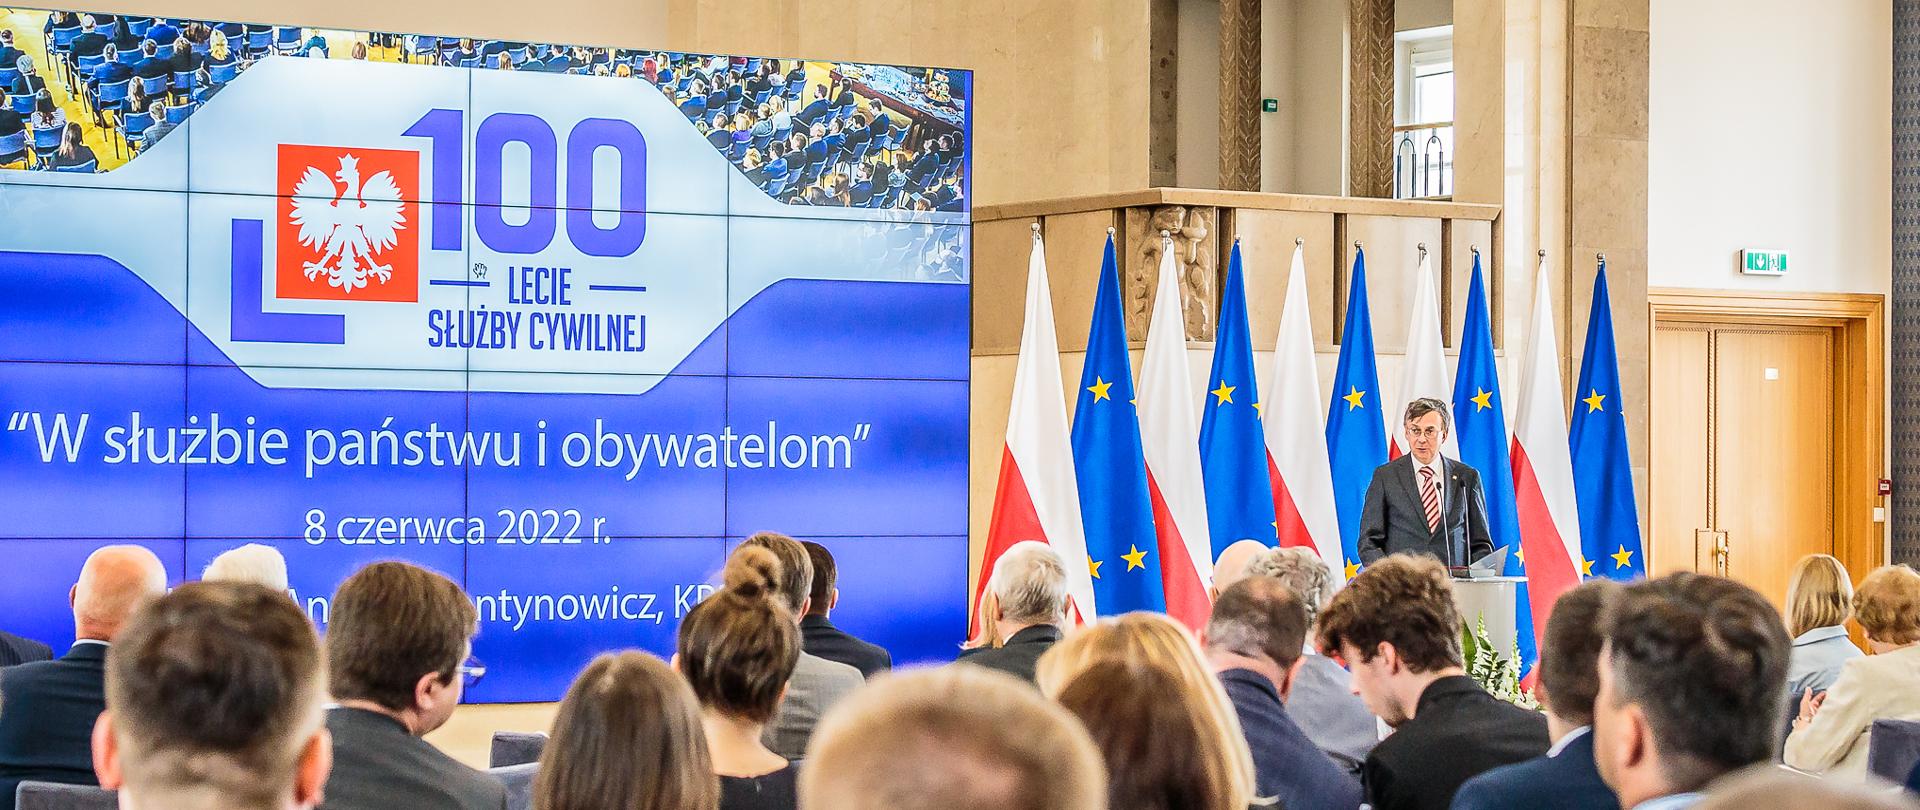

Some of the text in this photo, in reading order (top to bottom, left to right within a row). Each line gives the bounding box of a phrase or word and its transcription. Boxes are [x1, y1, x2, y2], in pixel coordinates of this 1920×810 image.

[400, 108, 647, 257] 100
[508, 266, 571, 305] LECIE
[428, 304, 646, 352] SŁUŻBY CYWILNEJ
[103, 412, 289, 465] służbie
[305, 416, 521, 478] państwu
[537, 420, 547, 467] i
[304, 509, 612, 545] 8 czerwca 2022 r.
[475, 585, 664, 631] ntynowicz,
